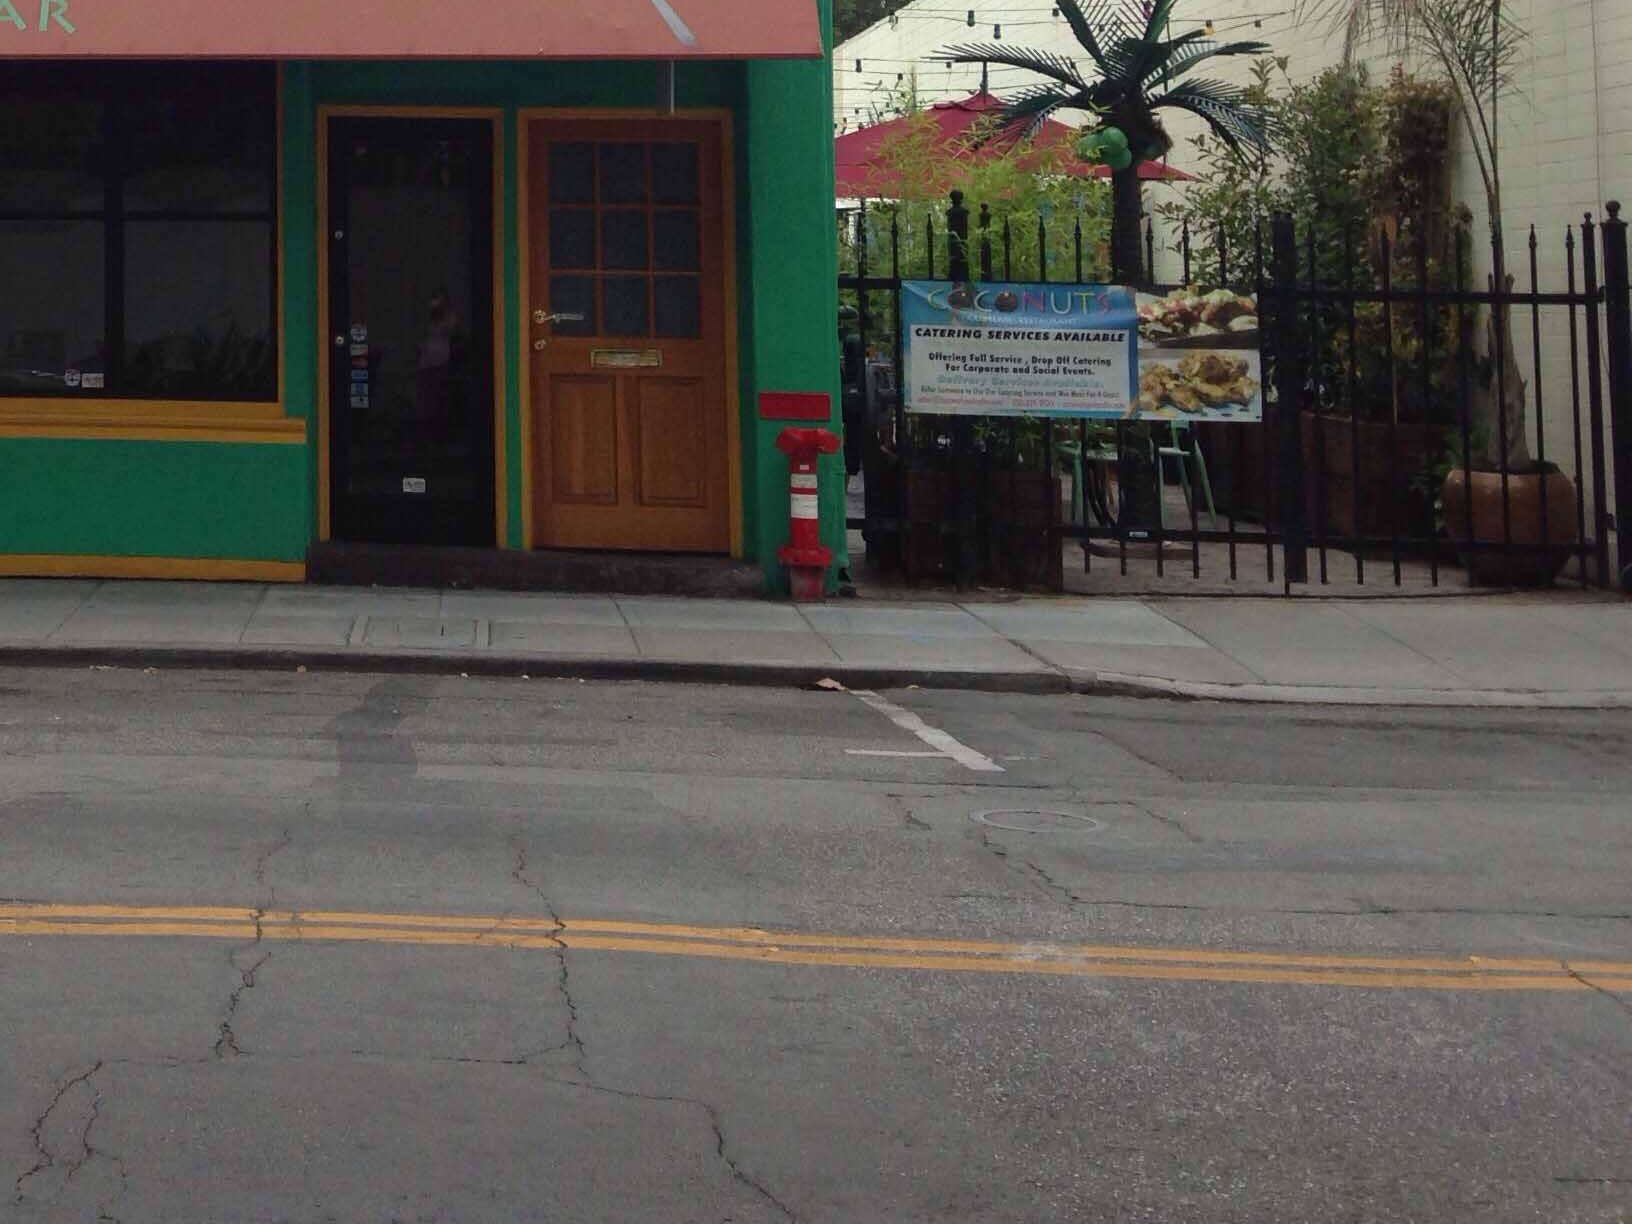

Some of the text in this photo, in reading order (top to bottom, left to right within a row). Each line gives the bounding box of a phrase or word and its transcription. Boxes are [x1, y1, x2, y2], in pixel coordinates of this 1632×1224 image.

[928, 289, 1113, 315] COCONUTS
[915, 327, 1126, 343] CATERING SERVICES AVAILABLE
[928, 351, 967, 364] Offering
[1031, 355, 1054, 367] Drop
[1056, 356, 1071, 365] Off
[1073, 356, 1112, 368] Catering
[945, 363, 961, 372] For
[1012, 365, 1030, 374] and
[1032, 365, 1059, 375] Social
